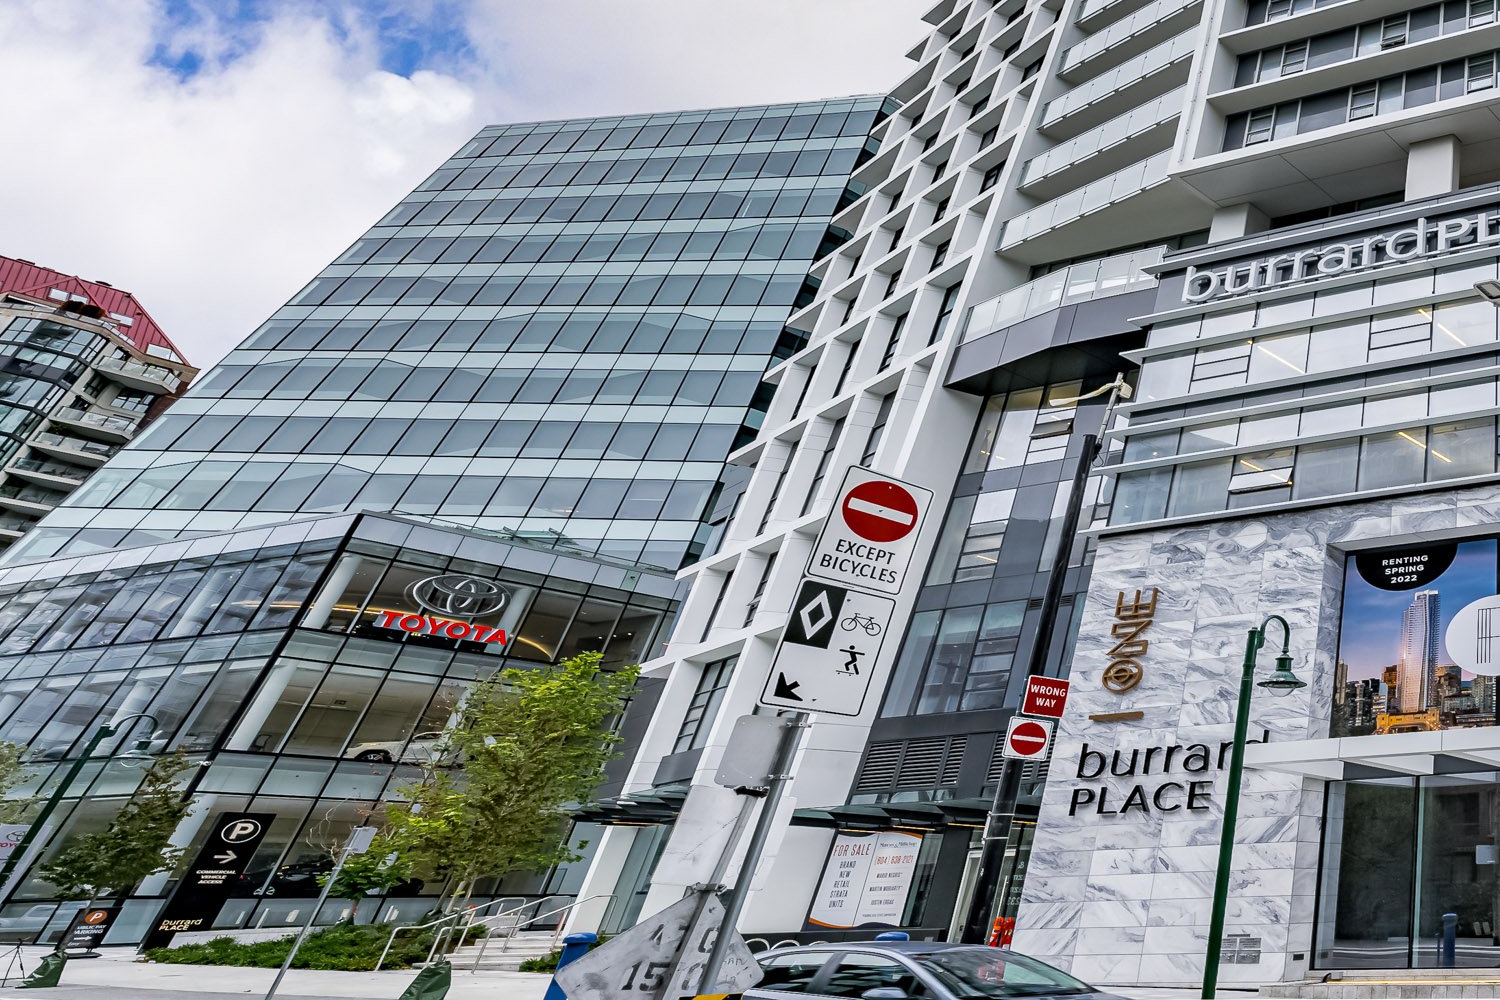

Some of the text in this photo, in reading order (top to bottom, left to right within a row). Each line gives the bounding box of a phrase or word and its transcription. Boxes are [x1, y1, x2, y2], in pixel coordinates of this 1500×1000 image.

[835, 539, 895, 565] EXCEPT
[1382, 555, 1429, 567] RENTING
[819, 553, 898, 584] BICYCLES
[1385, 564, 1425, 575] SPRING
[1390, 574, 1418, 584] 2022
[373, 610, 507, 646] TOYOTA
[1030, 684, 1066, 697] WRONG
[1036, 697, 1056, 708] WAY
[1068, 780, 1214, 817] PLACE
[228, 822, 255, 840] P
[833, 843, 872, 857] FOR SALE
[839, 860, 857, 869] BRAND
[839, 870, 851, 879] NEW
[833, 880, 850, 889] RETAIL
[830, 890, 848, 898] STRATA
[828, 899, 844, 909] UNITS
[89, 912, 103, 922] P
[158, 924, 190, 932] PLACE
